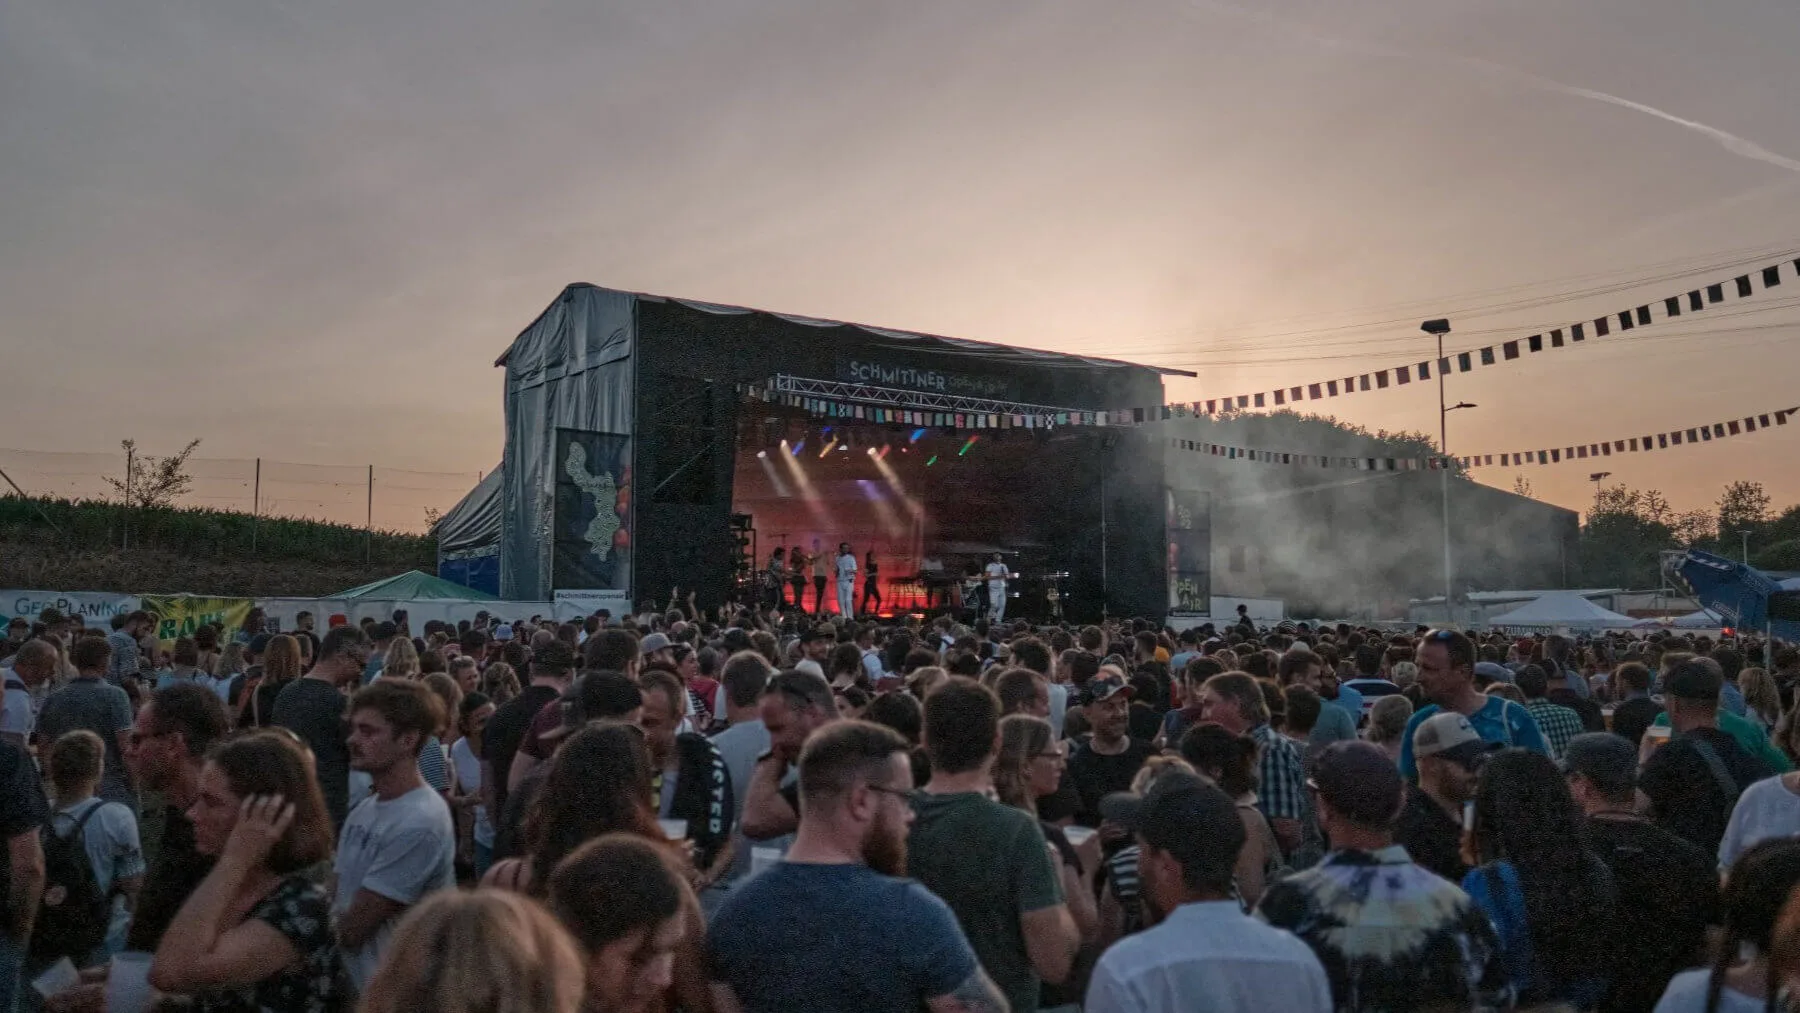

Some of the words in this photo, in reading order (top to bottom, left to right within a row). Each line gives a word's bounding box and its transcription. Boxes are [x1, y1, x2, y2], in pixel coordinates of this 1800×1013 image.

[849, 360, 945, 390] SCHMITTNER
[1171, 578, 1198, 595] OPEN
[1182, 593, 1203, 611] AIR
